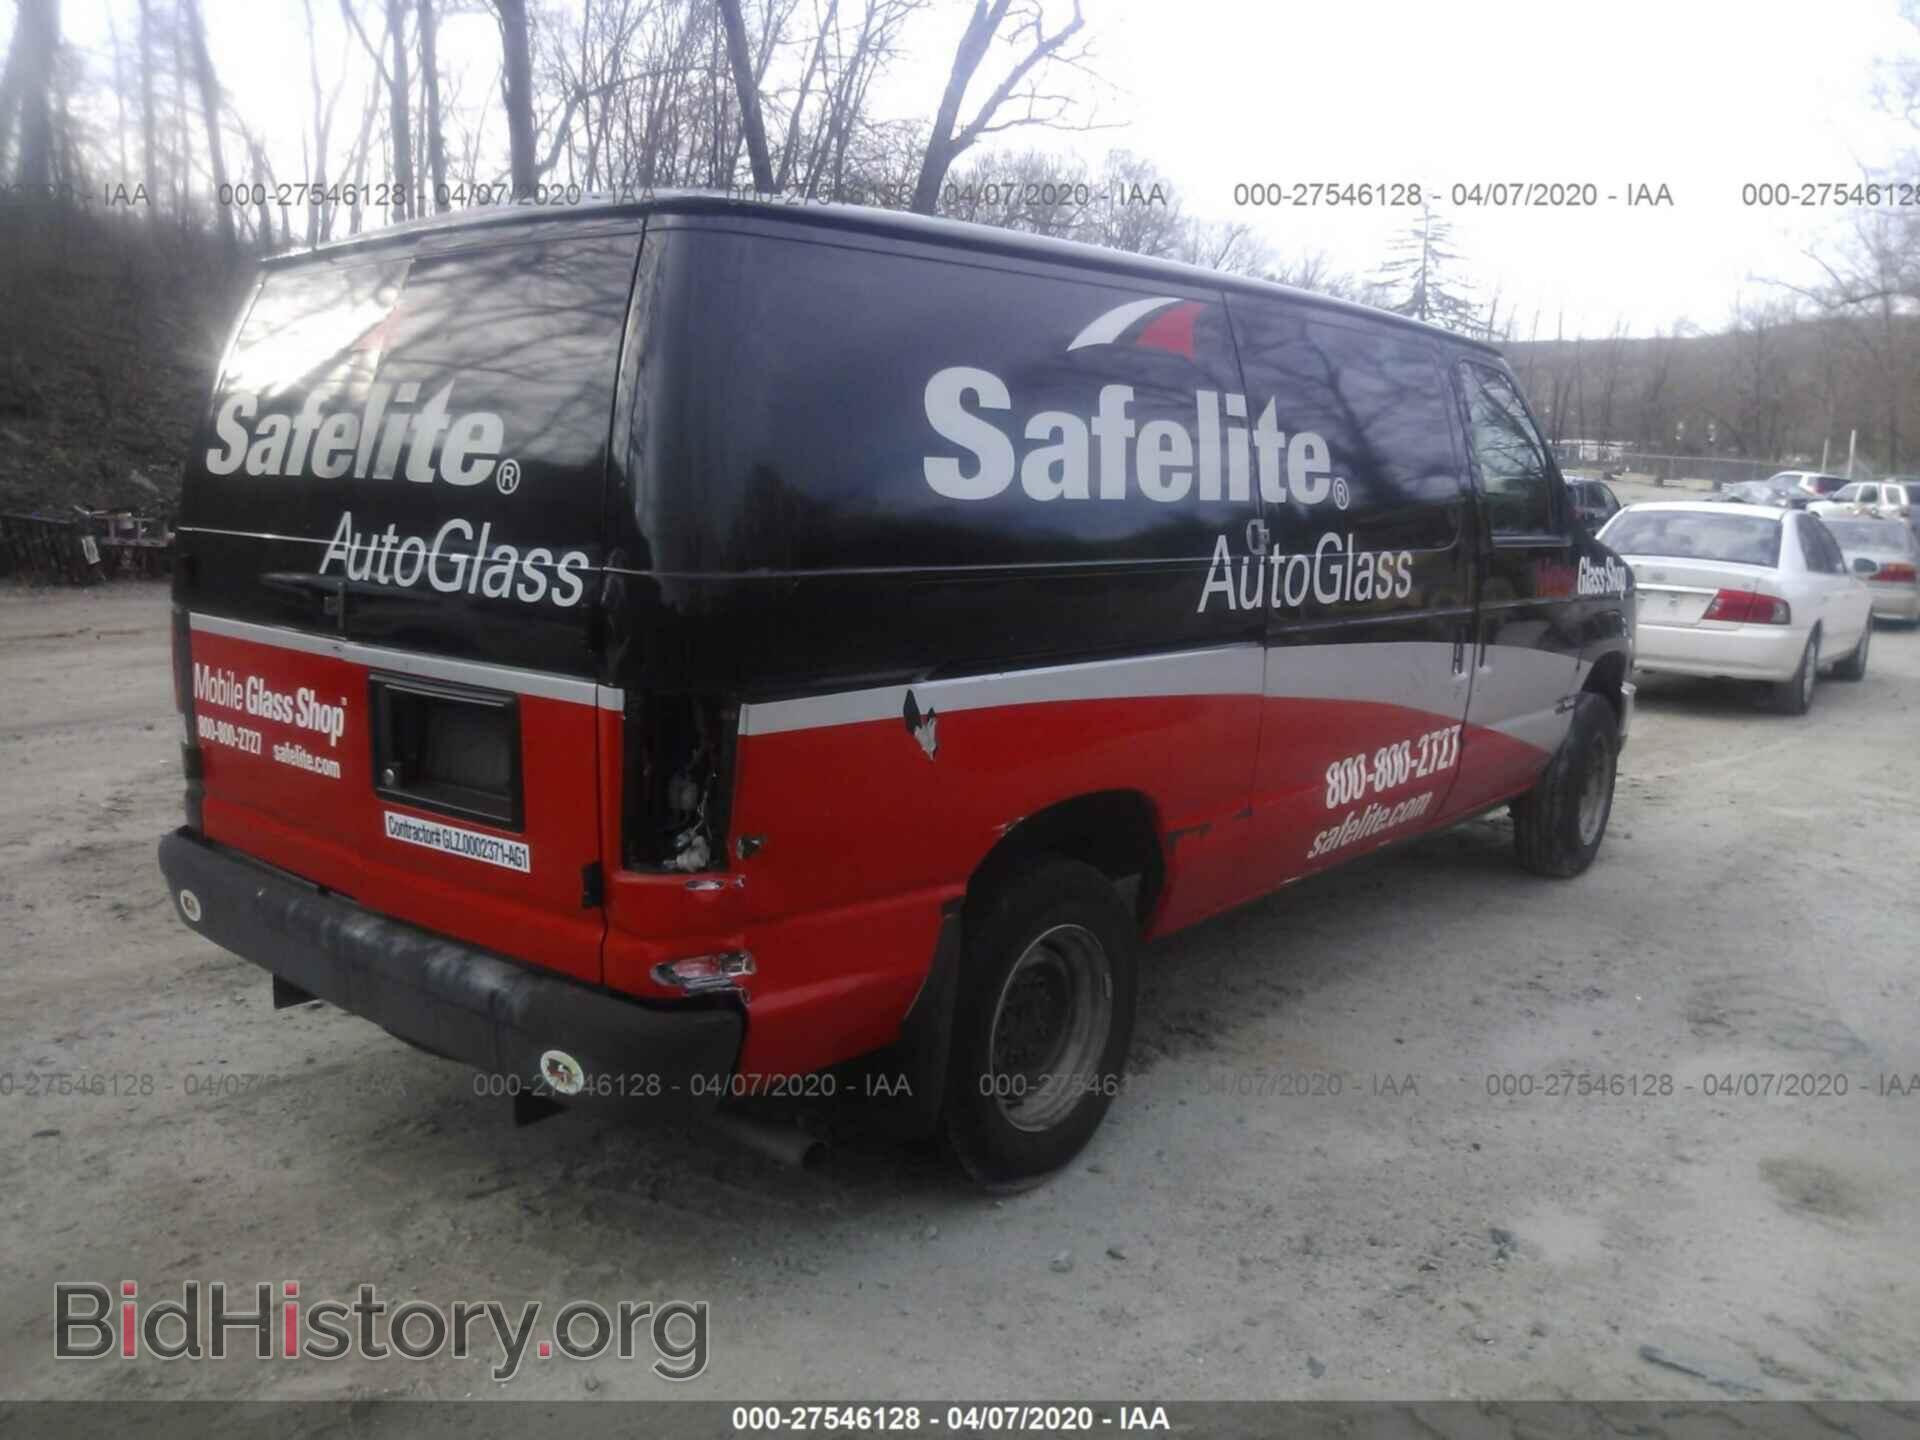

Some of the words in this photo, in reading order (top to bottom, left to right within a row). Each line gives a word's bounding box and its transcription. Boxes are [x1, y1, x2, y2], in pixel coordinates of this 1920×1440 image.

[318, 510, 590, 609] AutoGlass
[1197, 531, 1413, 614] AutoGlass
[193, 661, 244, 711] Mobile
[245, 675, 294, 725] Glass
[272, 741, 342, 780] safelite.com
[1325, 724, 1462, 810] 800-800-2727
[1306, 791, 1433, 860] safelite.com
